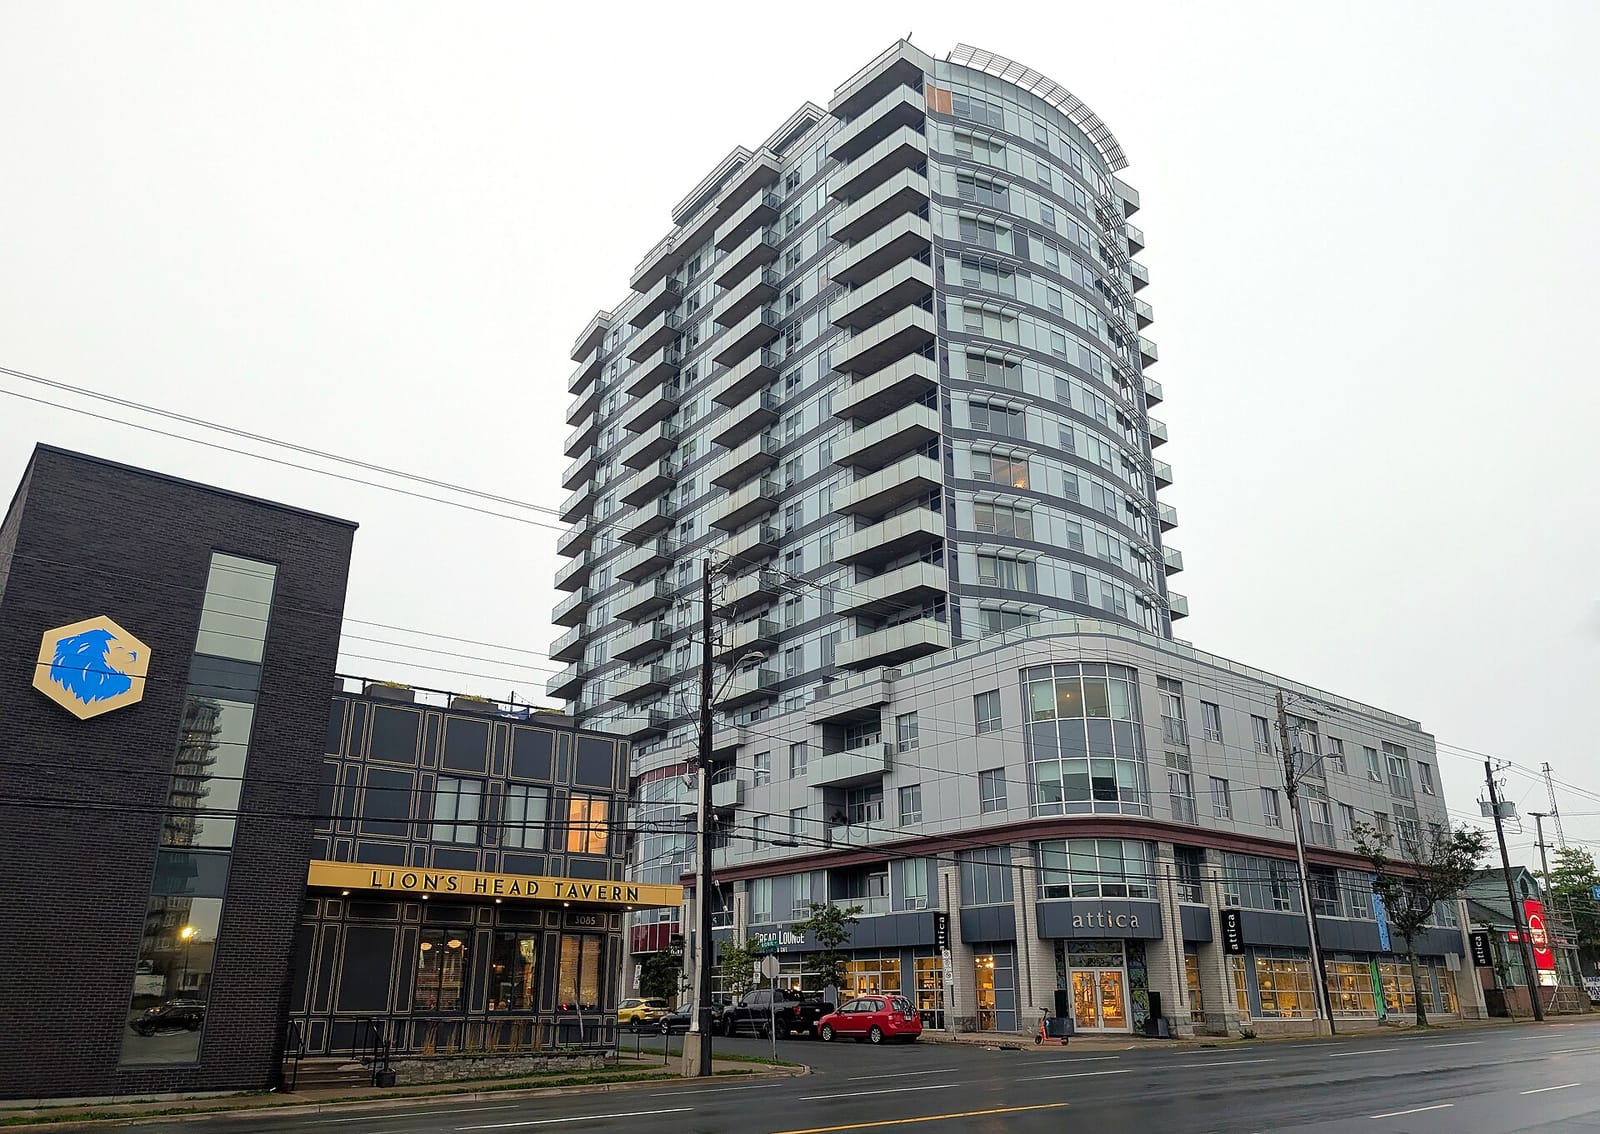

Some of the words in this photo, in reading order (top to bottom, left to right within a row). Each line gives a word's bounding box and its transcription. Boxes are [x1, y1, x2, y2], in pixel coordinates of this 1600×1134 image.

[371, 870, 457, 890] LION'S
[473, 878, 539, 895] HEAD
[555, 882, 639, 901] TAVERN
[575, 915, 596, 925] 3085
[1072, 910, 1140, 928] attica
[1227, 914, 1239, 950] attica
[1475, 936, 1486, 964] attica
